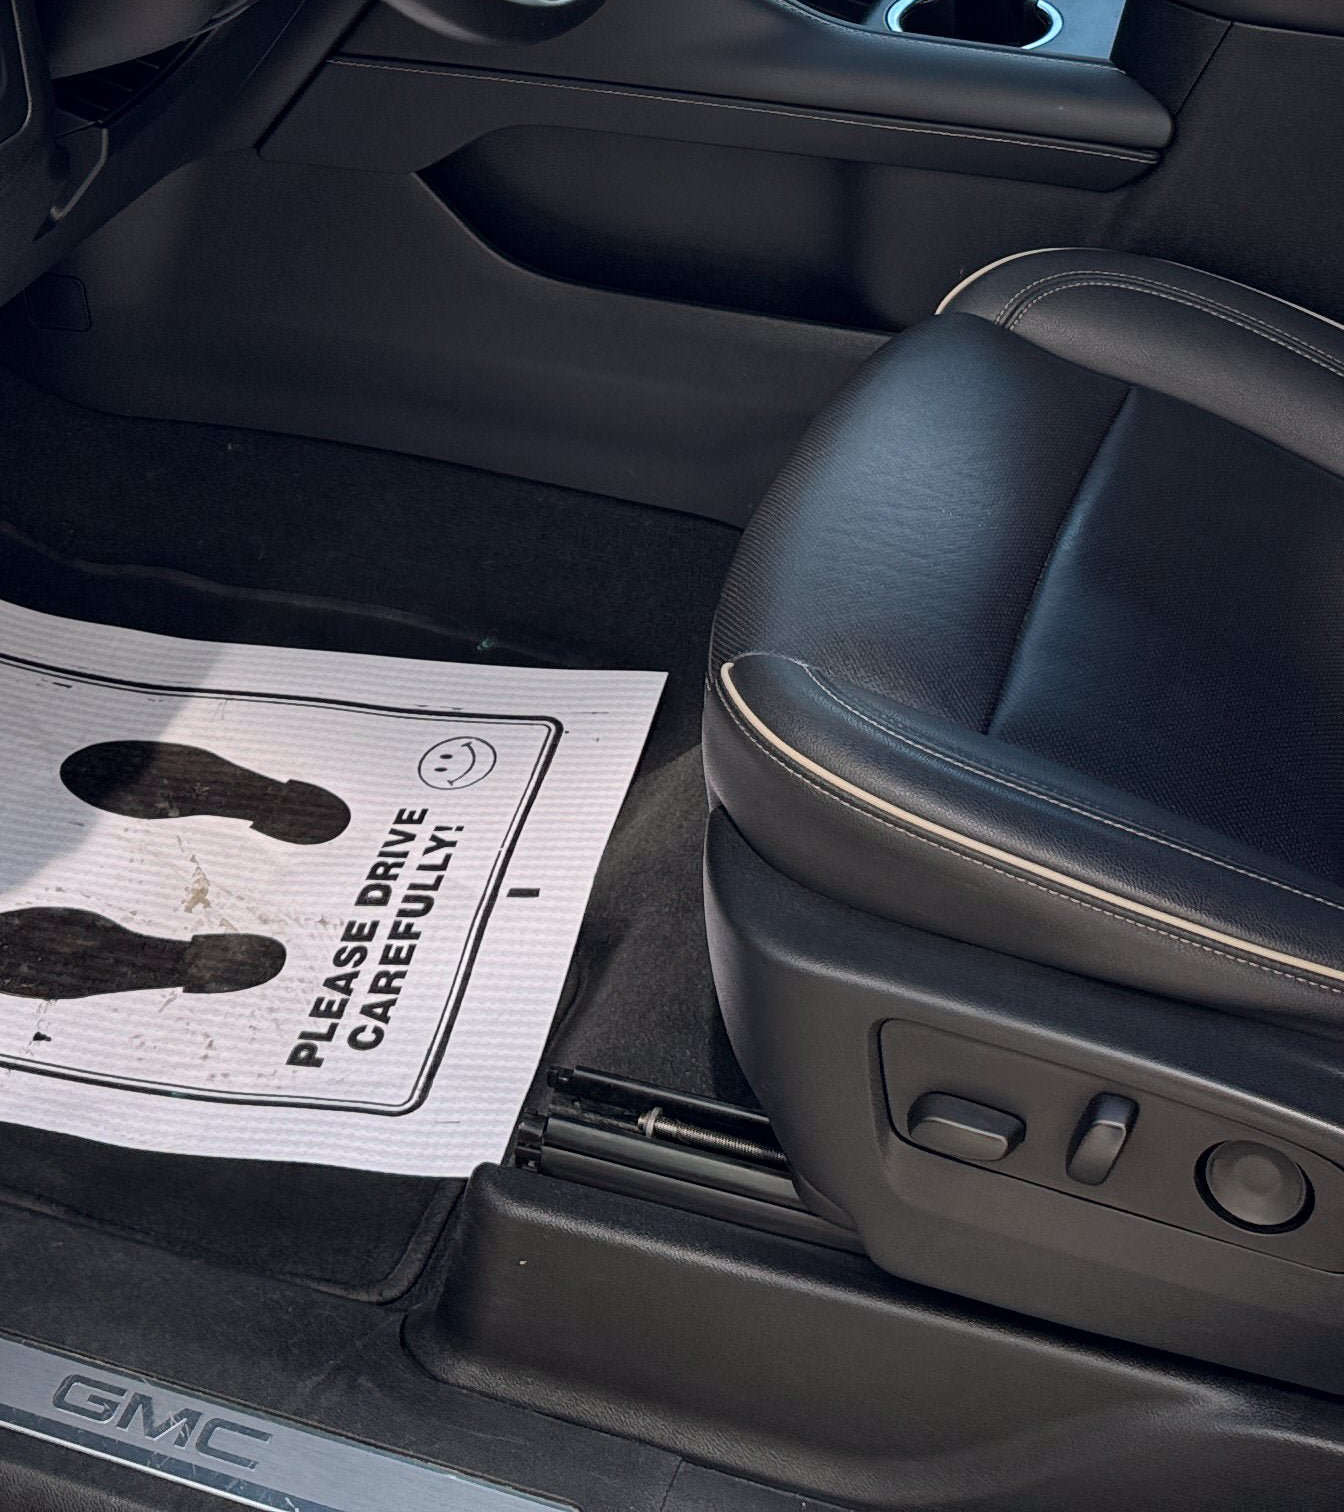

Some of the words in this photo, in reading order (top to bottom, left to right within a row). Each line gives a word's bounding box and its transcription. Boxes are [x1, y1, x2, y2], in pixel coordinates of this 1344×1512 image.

[285, 920, 380, 1068] PLEASE
[354, 808, 429, 906] DRIVE
[347, 826, 465, 1051] CAREFULLY!
[52, 1374, 273, 1471] GMC
